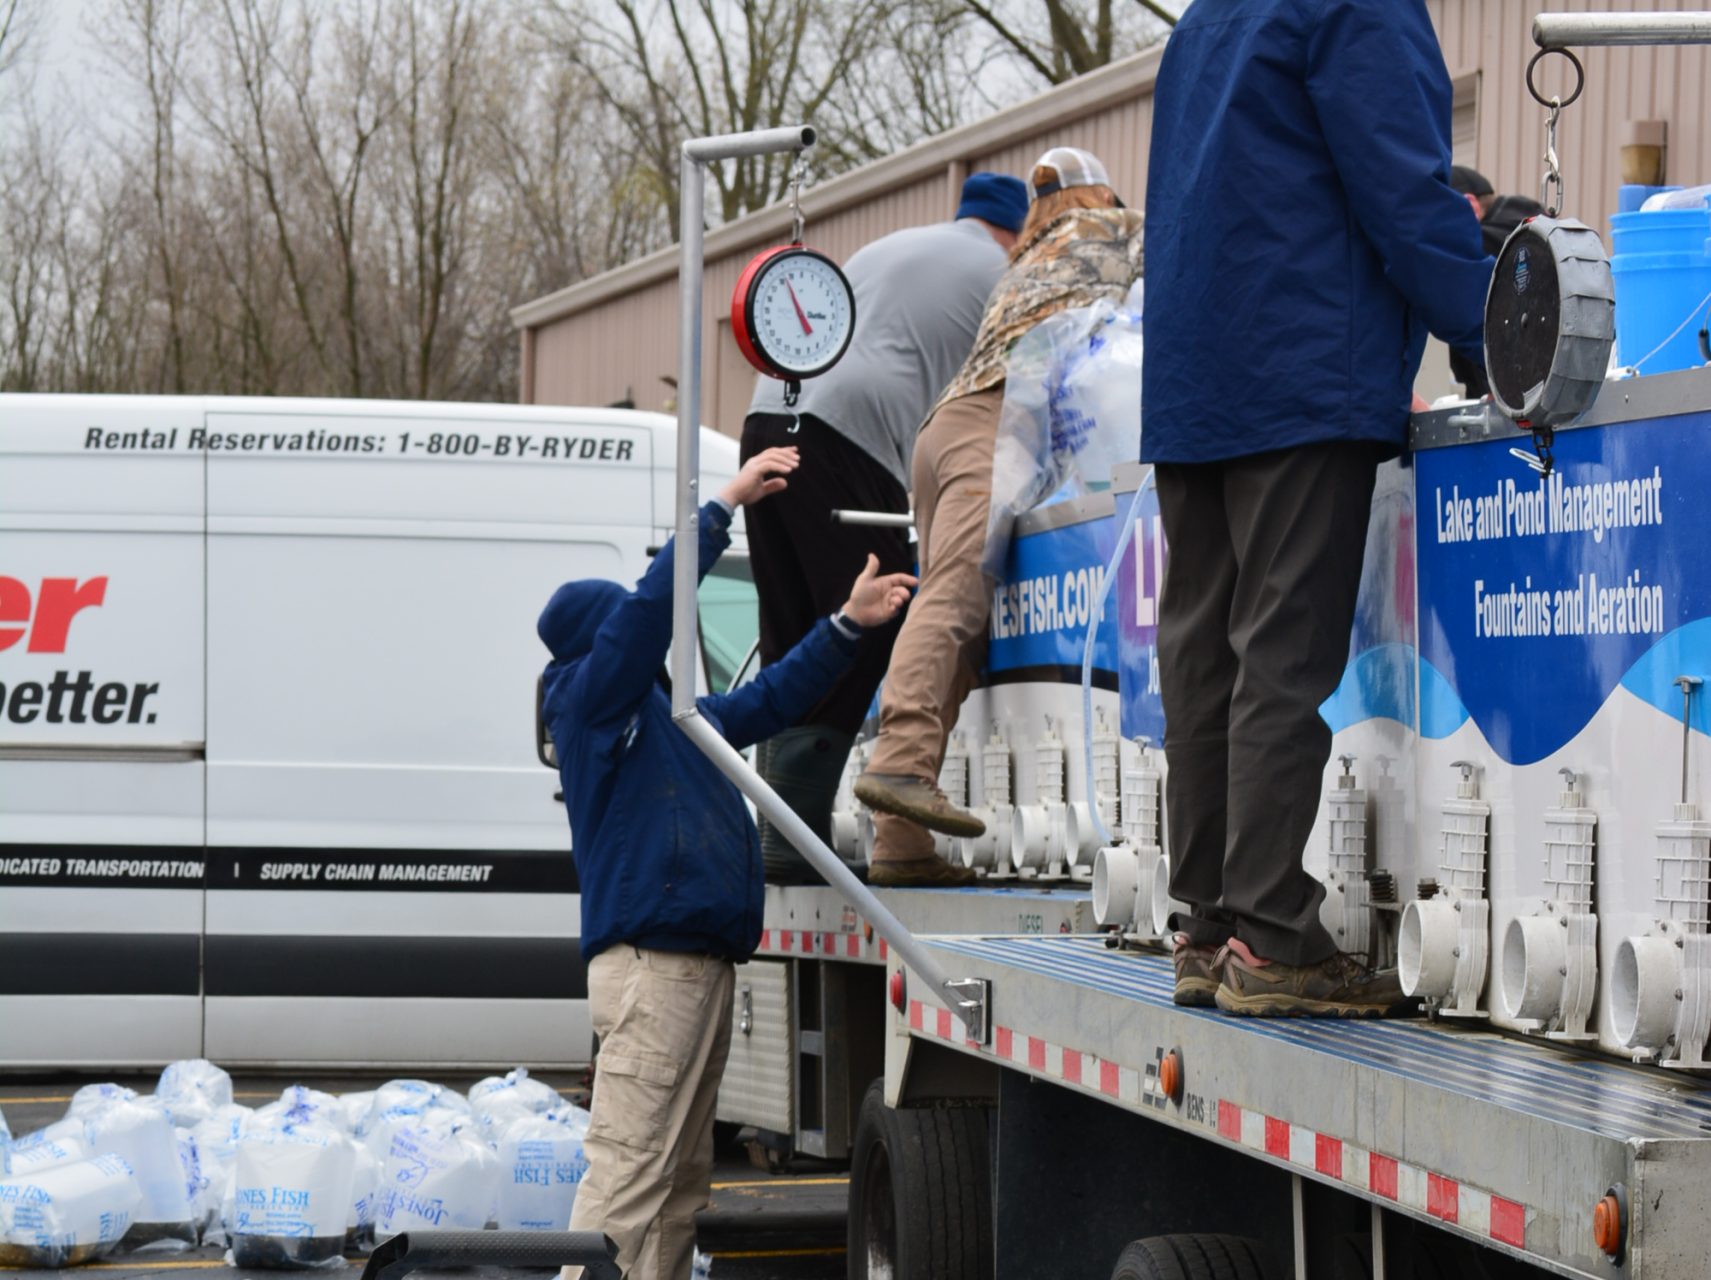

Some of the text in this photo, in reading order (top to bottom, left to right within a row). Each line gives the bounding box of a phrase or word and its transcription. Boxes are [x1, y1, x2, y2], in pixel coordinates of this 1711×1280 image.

[84, 427, 635, 461] Rental Reservations: 1-800-BY-RYDER
[1436, 465, 1663, 544] Lake and Pond Management
[1474, 568, 1664, 638] Fountains and Aeration
[0, 670, 160, 725] etter.
[65, 858, 205, 879] TRANSPORTATION
[259, 862, 493, 883] SUPPLY CHAIN MANAGEMENT
[271, 1186, 310, 1208] FISH
